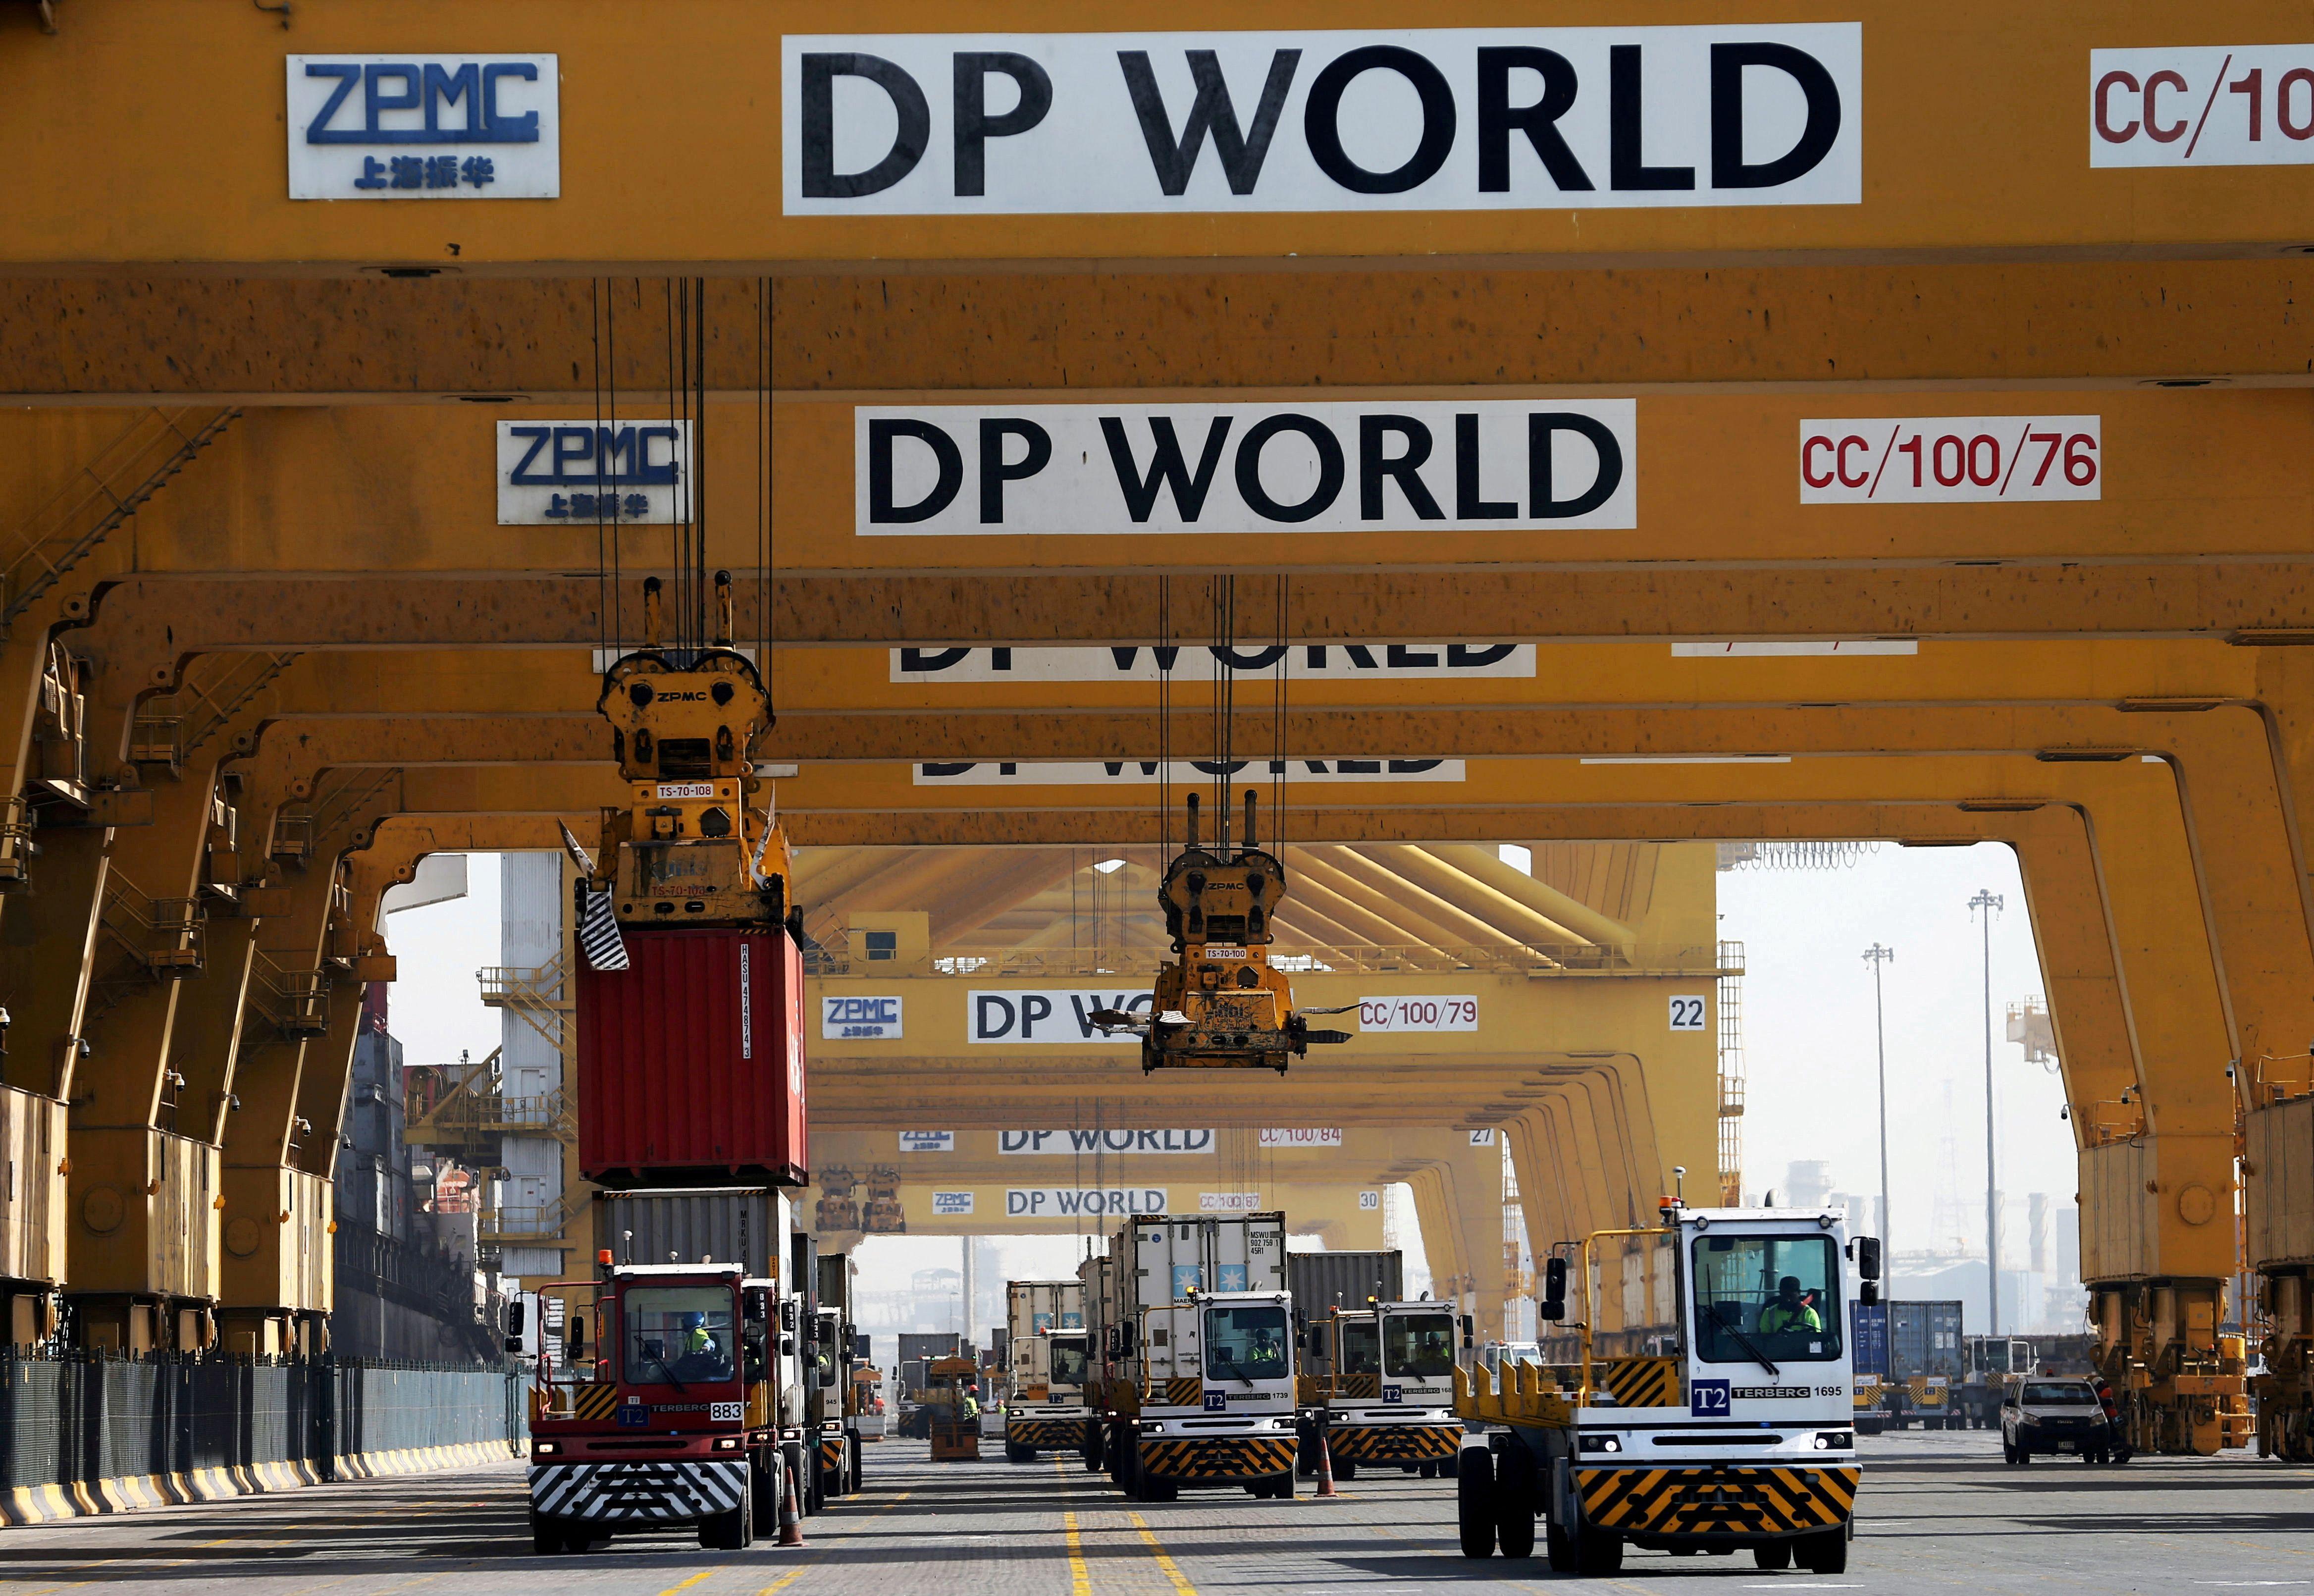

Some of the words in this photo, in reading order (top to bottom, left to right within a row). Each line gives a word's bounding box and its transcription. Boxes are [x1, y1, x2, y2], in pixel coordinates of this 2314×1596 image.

[304, 61, 540, 144] ZPMC
[801, 52, 1053, 198] DP
[1116, 42, 1841, 196] WORLD
[353, 155, 495, 188] 上海振华
[511, 426, 679, 485] ZPMC
[1802, 424, 2097, 497] CC/100/76
[869, 418, 1052, 524] DP
[1098, 412, 1623, 523] WORLD
[657, 692, 707, 702] ZPMC
[659, 786, 711, 797] TS-70-108
[1208, 882, 1245, 891] ZPMC
[828, 999, 897, 1023] ZPMC
[977, 995, 1052, 1039] DP
[1360, 998, 1476, 1029] CC/100/79
[1672, 1000, 1702, 1026] 22
[1002, 1130, 1052, 1151] DP
[1068, 1130, 1210, 1150] WORLD
[1472, 1128, 1491, 1143] 27
[936, 1193, 971, 1206] ZPMC
[1008, 1191, 1046, 1215] DP
[1056, 1190, 1165, 1214] WORLD
[1361, 1193, 1377, 1207] 30
[1050, 1394, 1062, 1402] T2
[1206, 1394, 1223, 1406] T2
[1384, 1388, 1400, 1399] T2
[1694, 1388, 1727, 1408] T2
[1734, 1388, 1809, 1397] TERBERG
[1814, 1386, 1842, 1396] 1695
[623, 1409, 644, 1423] T2
[712, 1404, 741, 1419] 883
